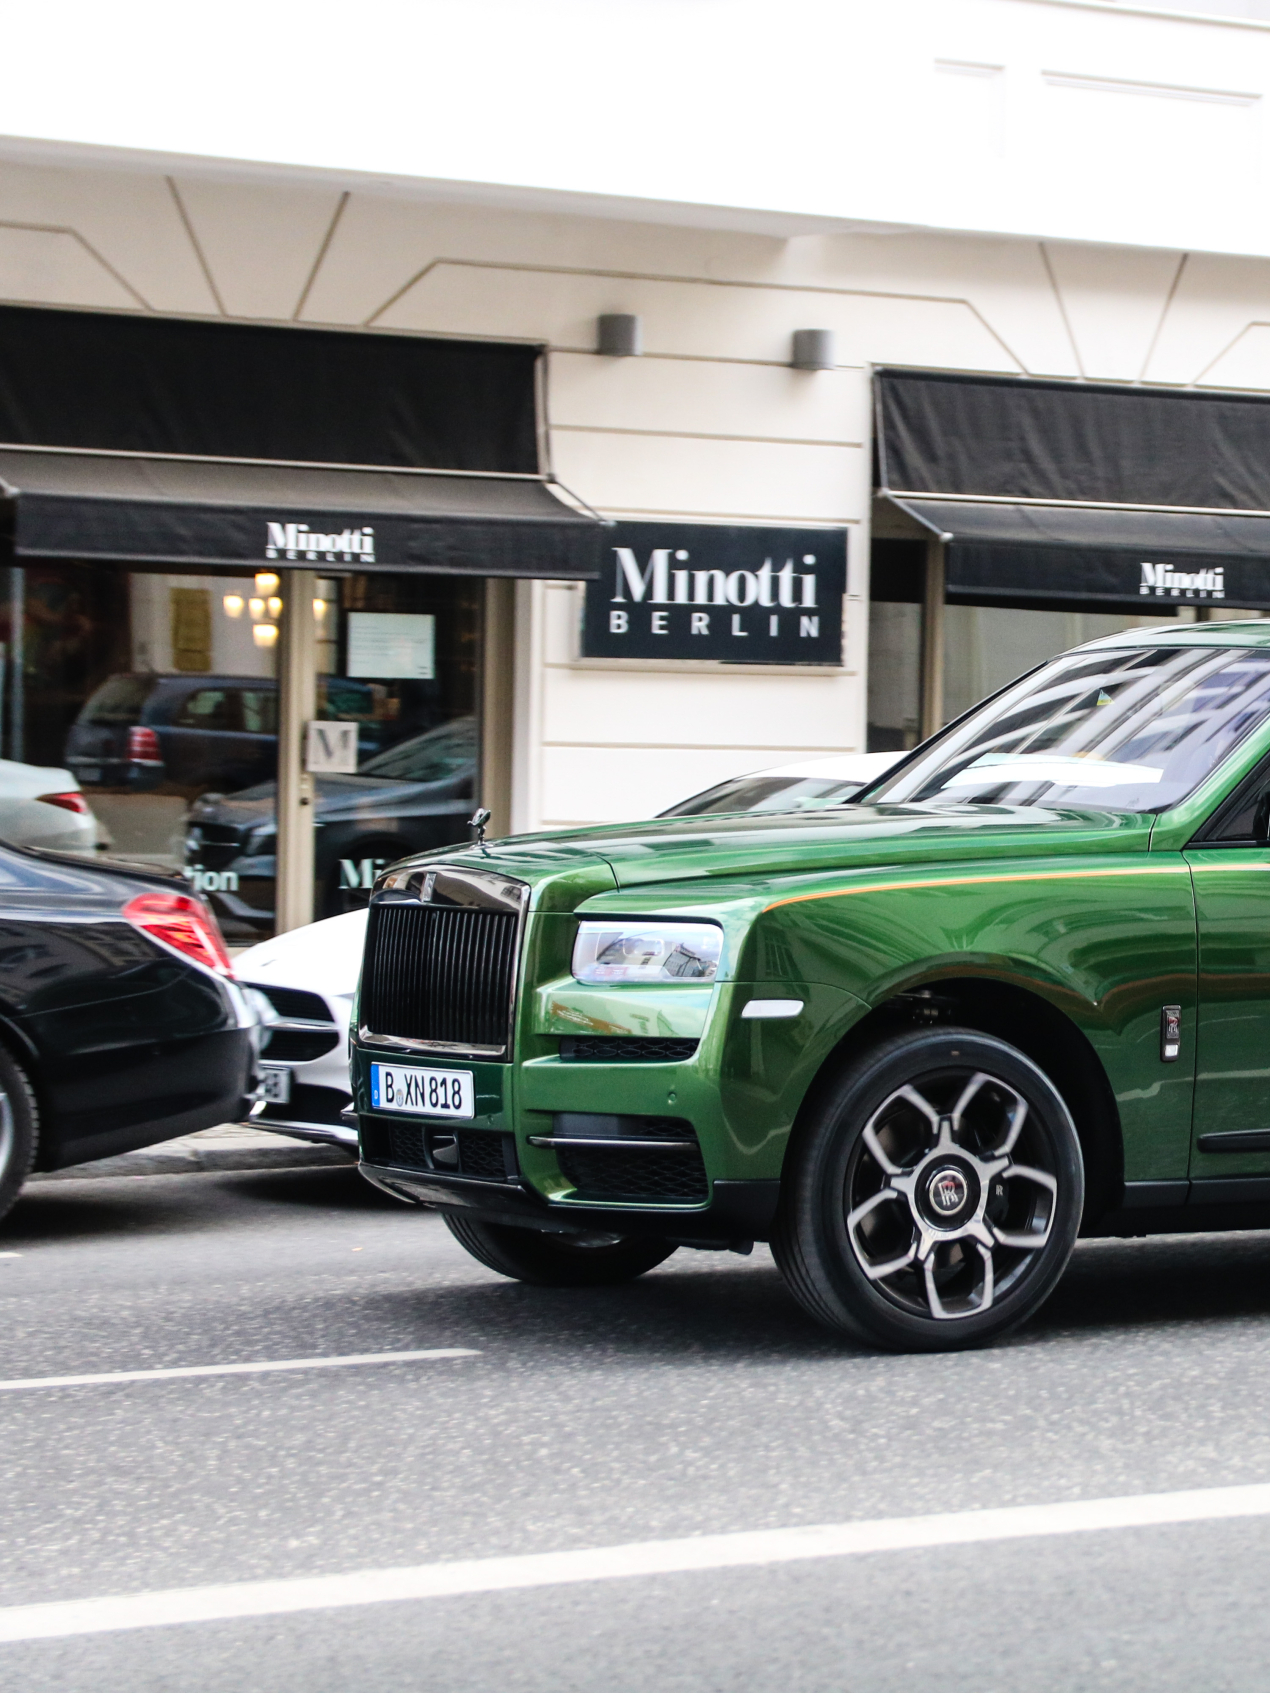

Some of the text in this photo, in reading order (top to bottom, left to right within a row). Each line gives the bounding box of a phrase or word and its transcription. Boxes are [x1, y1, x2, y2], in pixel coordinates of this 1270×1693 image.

[265, 521, 375, 553] Minotti
[265, 549, 376, 563] BERLIN
[611, 547, 819, 608] Minotti
[1140, 562, 1224, 591] Minotti
[1139, 586, 1225, 599] BERLIN
[609, 610, 820, 637] BERLIN
[338, 858, 386, 890] Mi
